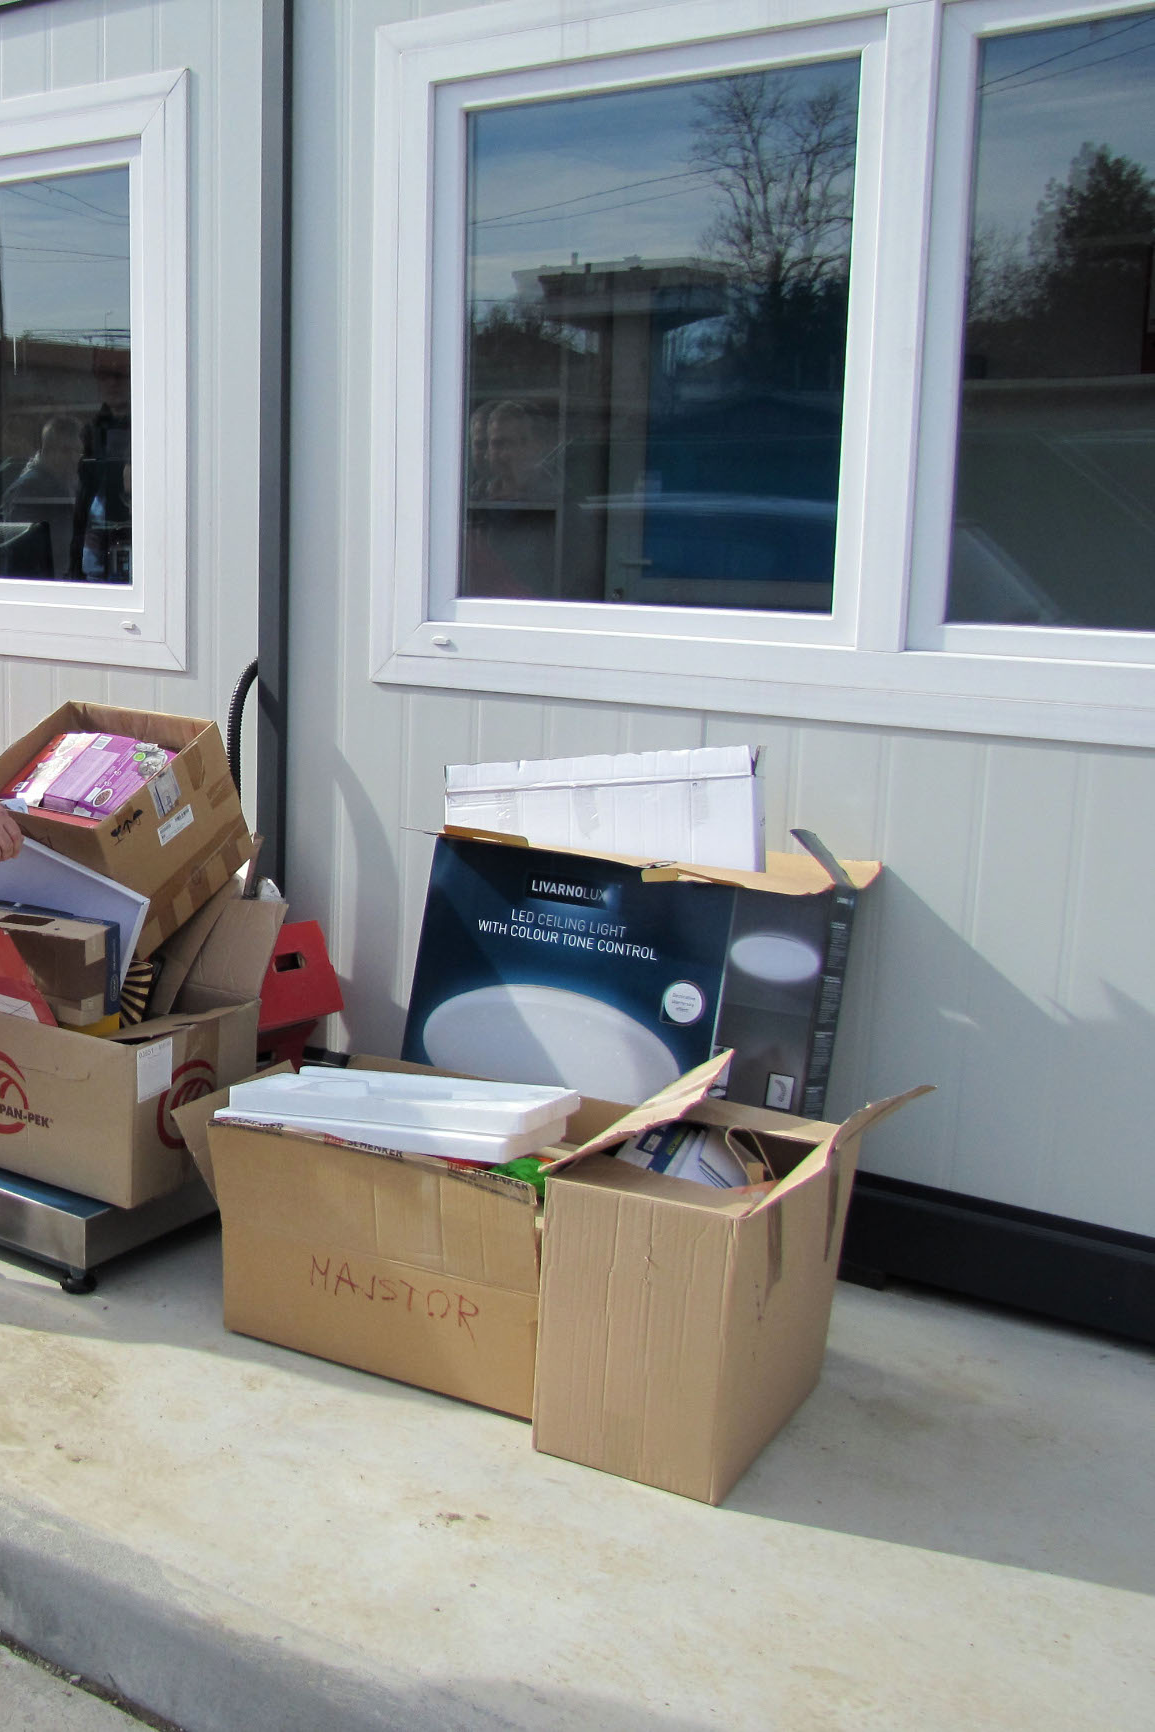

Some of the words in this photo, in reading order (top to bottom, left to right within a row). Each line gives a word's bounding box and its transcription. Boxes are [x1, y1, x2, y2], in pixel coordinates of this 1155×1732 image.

[531, 879, 606, 901] LIVARNOLUX
[511, 908, 535, 924] LED
[537, 913, 586, 932] CEILING
[589, 921, 626, 938] LIGHT
[478, 919, 507, 935] WITH
[510, 924, 559, 944] COLOUR
[562, 932, 595, 950] TONE
[597, 939, 657, 961] CONTROL
